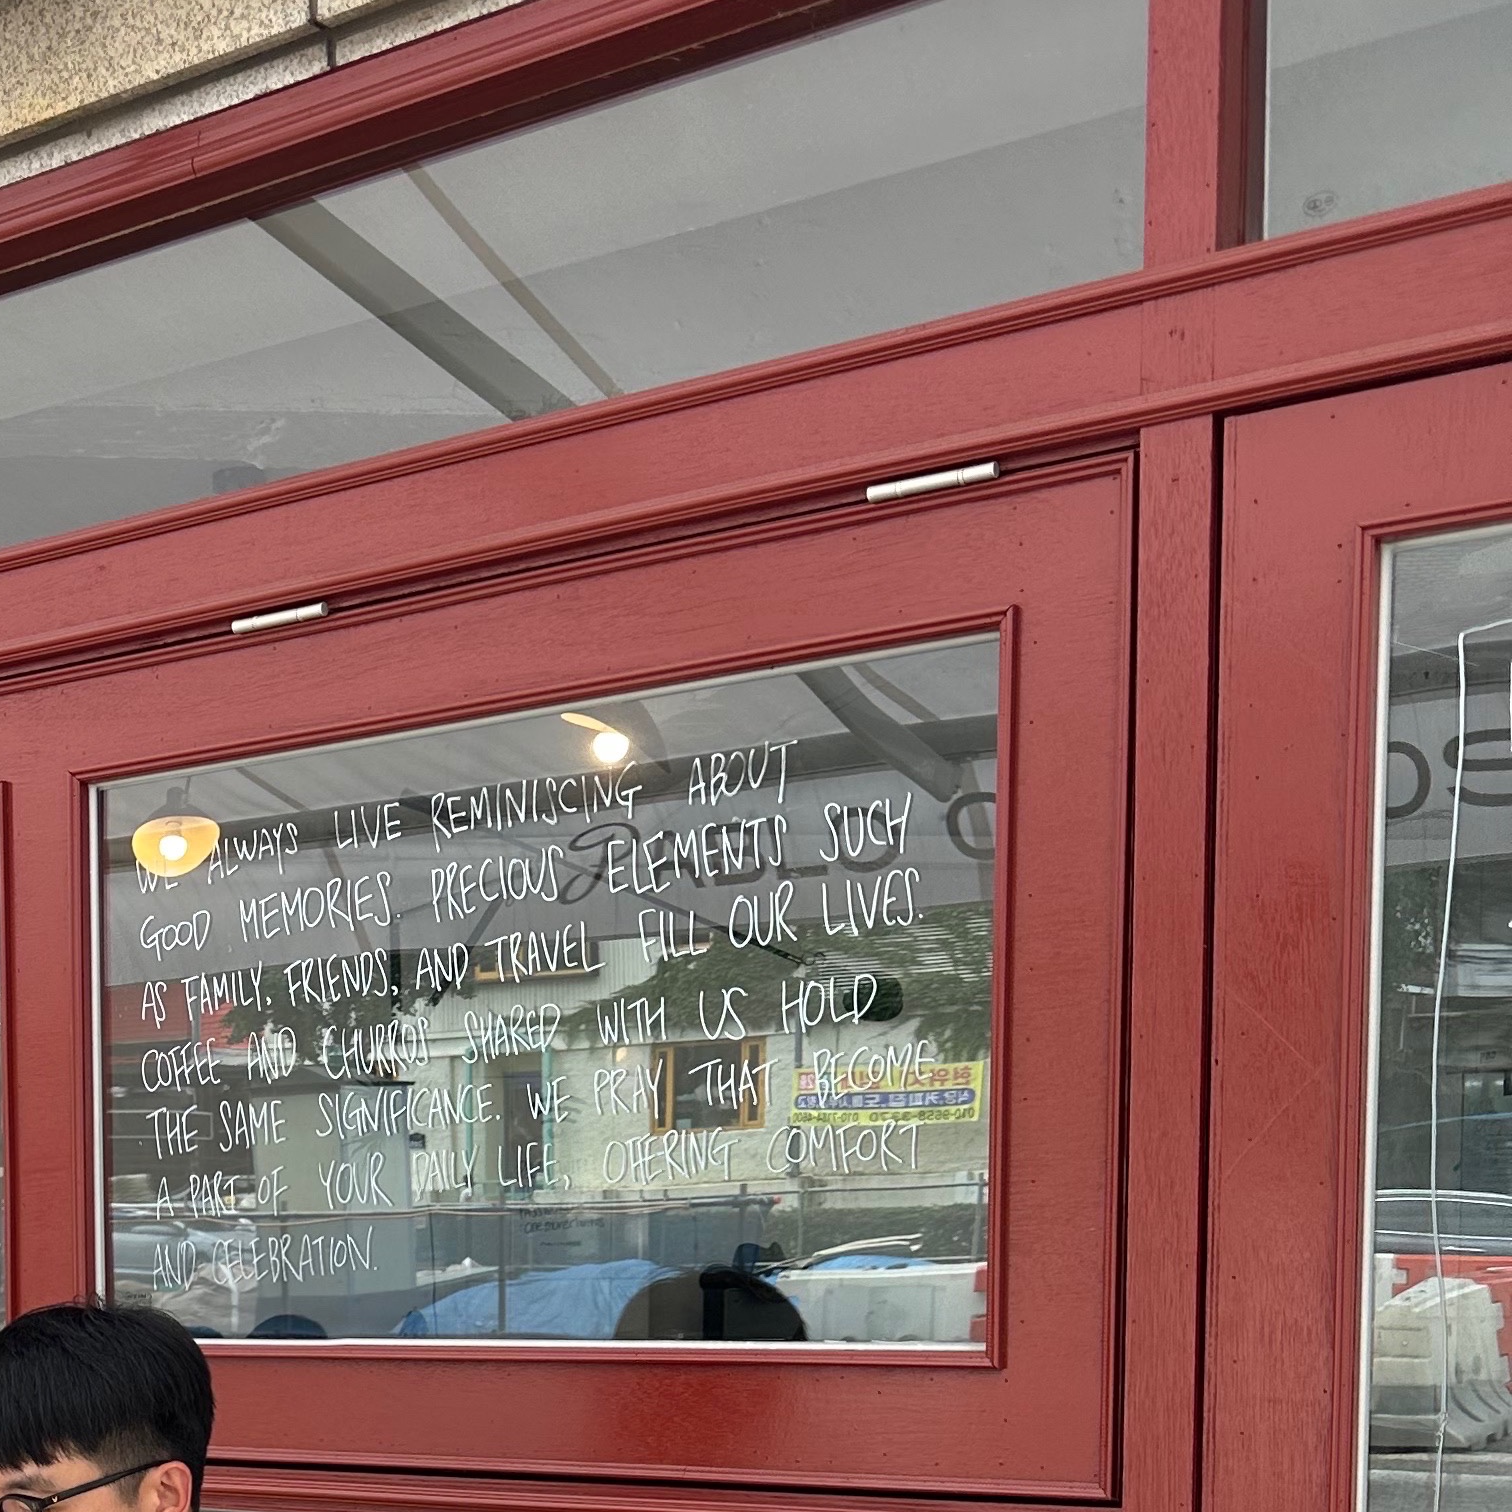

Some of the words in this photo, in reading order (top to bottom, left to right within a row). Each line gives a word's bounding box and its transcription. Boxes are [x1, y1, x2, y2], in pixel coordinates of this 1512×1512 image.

[208, 822, 298, 885] ALWAYS
[334, 802, 402, 849] LIVE
[431, 761, 643, 852] REMINISCING
[688, 739, 798, 806] ABOUT
[140, 910, 211, 961] GOOD
[239, 871, 403, 942] MEMORIES.
[431, 844, 564, 923] PRECIOUS
[607, 814, 787, 894] ELEMENTS
[819, 791, 913, 861] SUCH
[141, 980, 167, 1029] AS
[284, 947, 398, 1007] FRIENDS,
[416, 941, 469, 992] AND
[484, 921, 606, 985] TRAVEL
[638, 908, 708, 963] FILL
[728, 880, 798, 948] OUR
[822, 867, 924, 936] LIVES.
[140, 1038, 222, 1093] COFFEE
[247, 1027, 296, 1084] AND
[323, 1015, 429, 1081] CHURROS
[461, 1003, 561, 1065] SHARED
[597, 996, 667, 1046] WITH
[699, 987, 749, 1041] US
[781, 973, 878, 1034] HOLD
[145, 1104, 199, 1160] THE
[218, 1099, 287, 1154] SAME
[315, 1083, 501, 1140] SIGNIFICANCE.
[526, 1075, 571, 1123] WE
[592, 1058, 665, 1120] PRAY
[687, 1058, 779, 1110] THAT
[811, 1039, 936, 1107] BECOME
[155, 1176, 176, 1220] A
[188, 1170, 238, 1218] PART
[257, 1164, 288, 1216] OF
[317, 1151, 394, 1210] YOUR
[413, 1144, 478, 1202] DAILY
[497, 1141, 571, 1190] LIFE,
[602, 1126, 741, 1184] OFFERING
[766, 1120, 926, 1175] COMFORT
[152, 1240, 196, 1291] AND
[211, 1225, 378, 1285] CELEBRATION.
